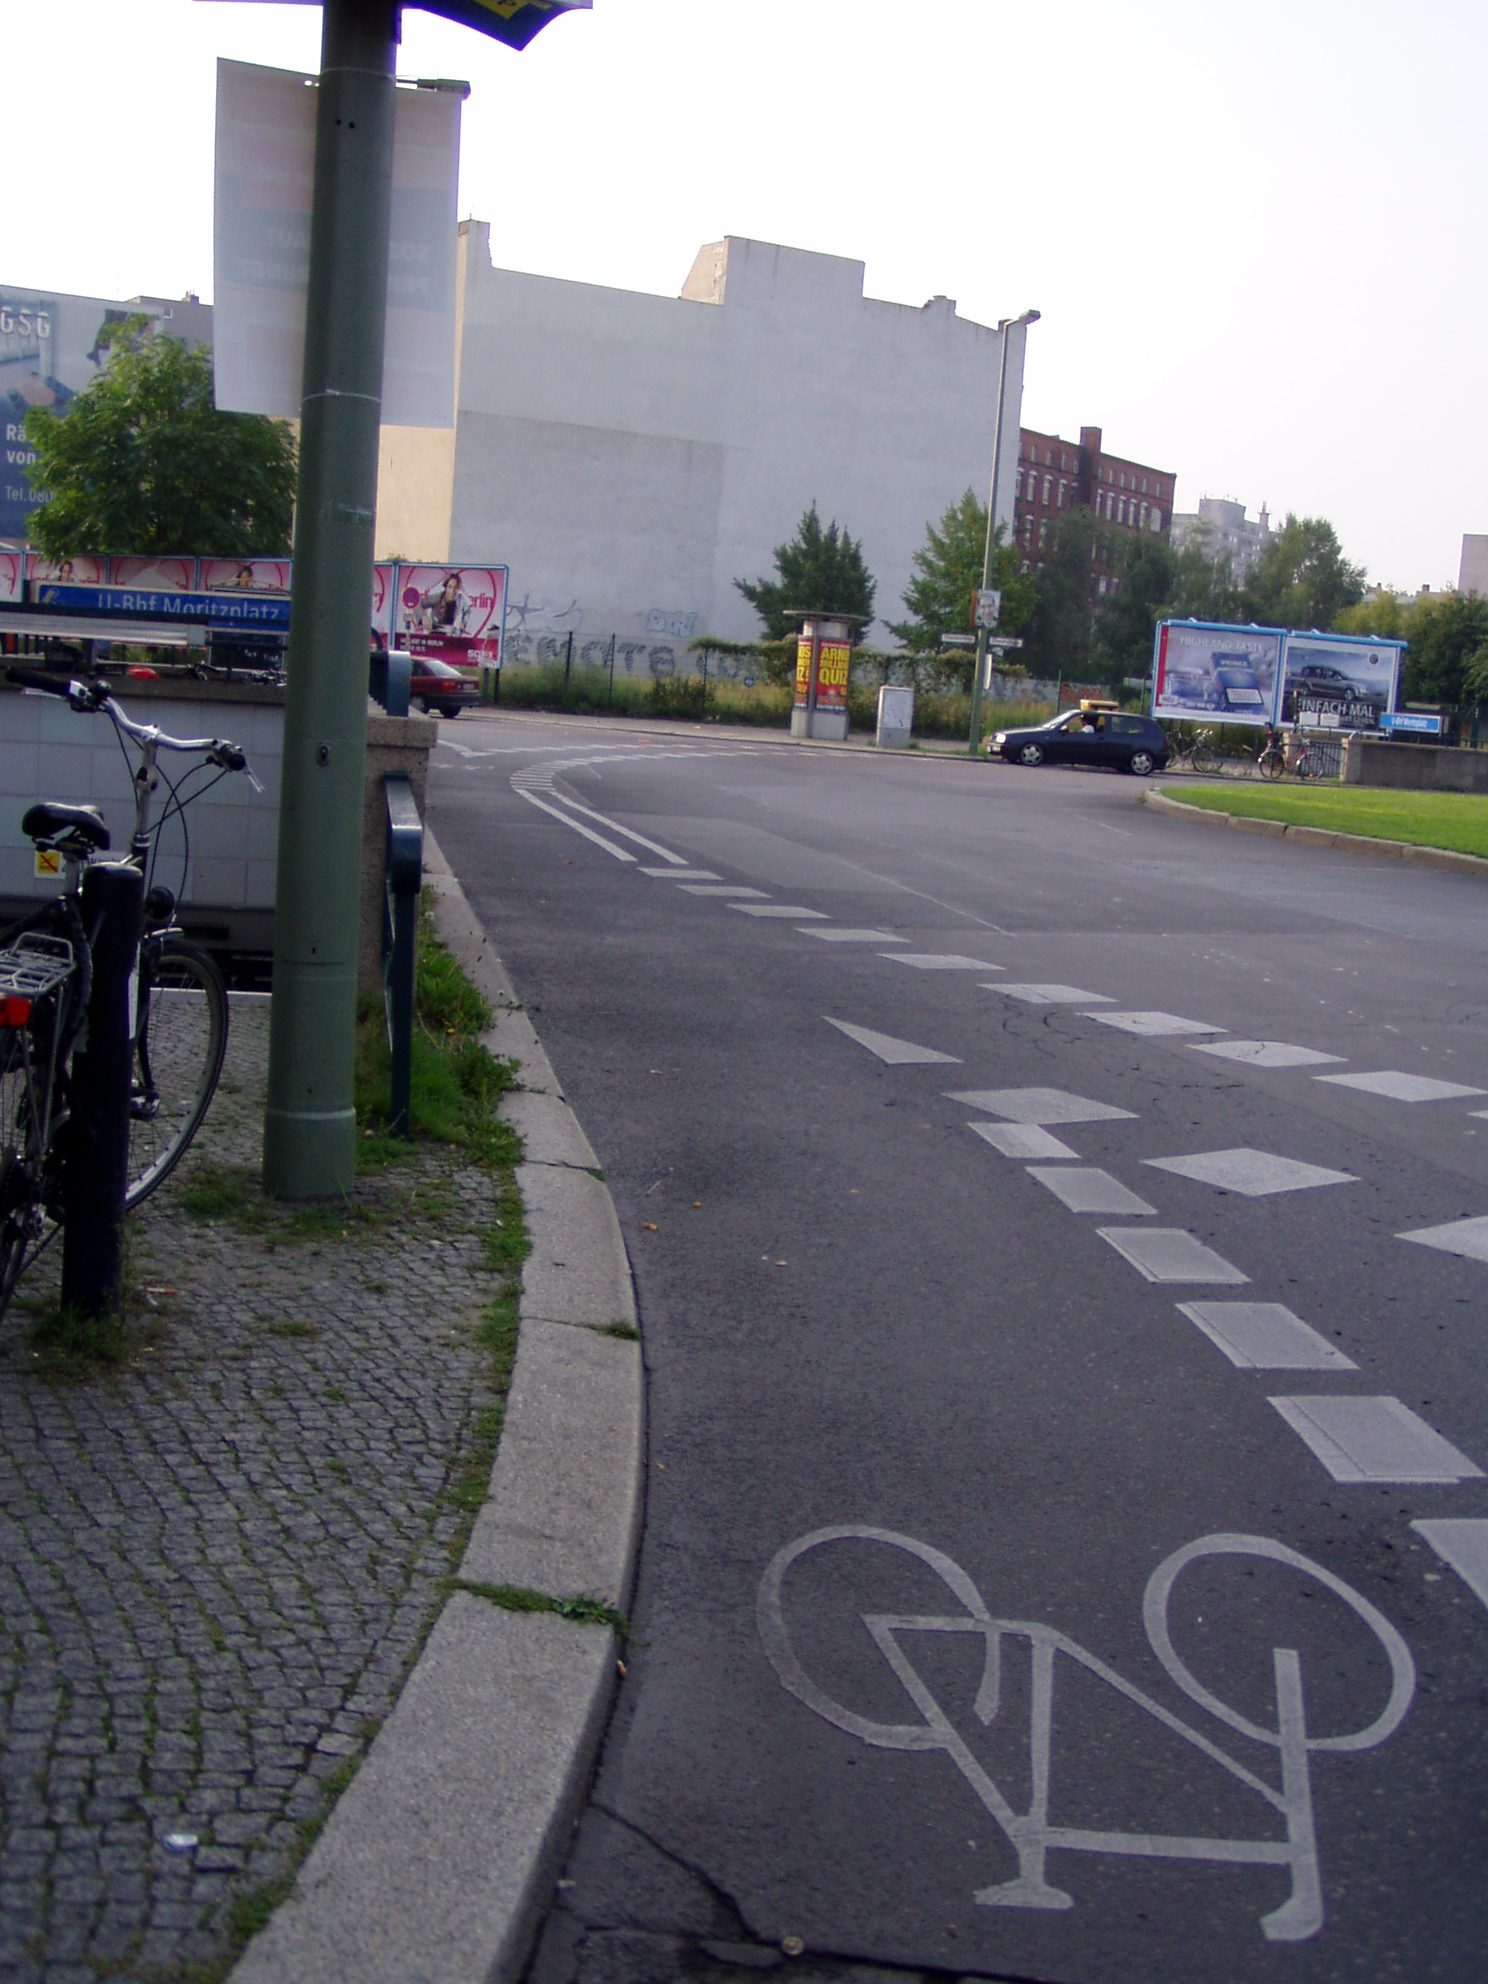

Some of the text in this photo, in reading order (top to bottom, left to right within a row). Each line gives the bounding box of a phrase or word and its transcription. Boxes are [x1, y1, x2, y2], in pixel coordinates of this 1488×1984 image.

[1, 306, 50, 339] GSG
[6, 451, 36, 465] von
[5, 486, 27, 501] Tel.
[1349, 703, 1375, 718] MAL
